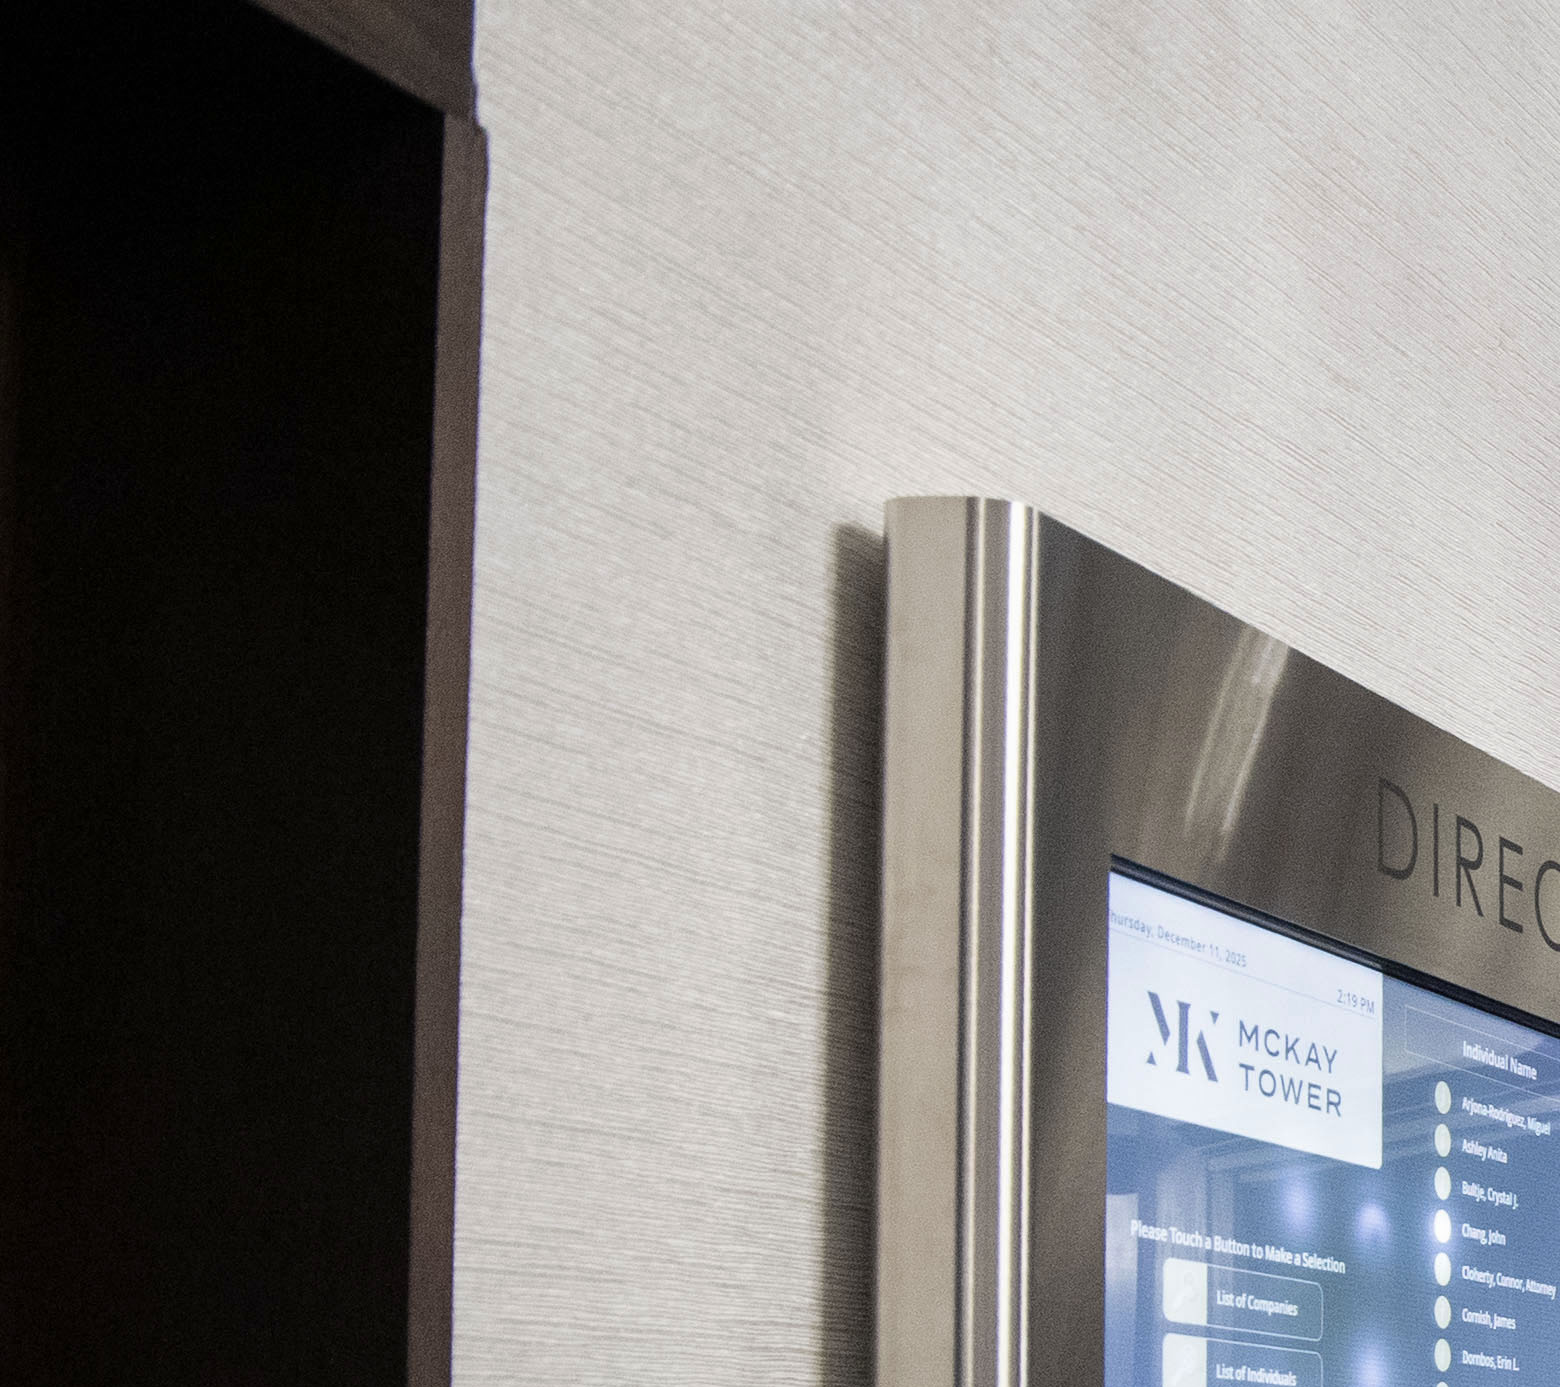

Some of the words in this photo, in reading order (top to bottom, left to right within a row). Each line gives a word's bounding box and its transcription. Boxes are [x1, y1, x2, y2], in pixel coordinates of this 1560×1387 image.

[1157, 925, 1206, 950] December
[1225, 947, 1247, 968] 2025
[1337, 989, 1358, 1008] 2:19
[1360, 997, 1375, 1014] PM
[1239, 1020, 1337, 1074] MCKAY
[1463, 1041, 1508, 1069] Individual
[1510, 1057, 1536, 1080] Name
[1238, 1063, 1341, 1117] TOWER
[1527, 1117, 1550, 1136] Miguel
[1462, 1139, 1486, 1161] Ashley
[1487, 1147, 1507, 1163] Anita
[1487, 1188, 1512, 1206] Crystal
[1131, 1219, 1167, 1242] Please
[1169, 1227, 1202, 1248] Touch
[1205, 1237, 1211, 1249] a
[1214, 1235, 1249, 1256] Button
[1252, 1244, 1262, 1259] to
[1265, 1245, 1292, 1264] Make
[1294, 1254, 1300, 1266] a
[1302, 1252, 1346, 1273] Selection
[1462, 1223, 1487, 1244] Chang,
[1488, 1230, 1506, 1245] John
[1462, 1266, 1495, 1288] Cloherty,
[1496, 1273, 1525, 1292] Connor,
[1526, 1279, 1556, 1299] Attorney
[1216, 1290, 1234, 1306] List
[1236, 1293, 1246, 1308] of
[1247, 1295, 1298, 1316] Companies
[1462, 1308, 1492, 1328] Cornish,
[1493, 1314, 1516, 1329] James
[1216, 1364, 1233, 1379] List
[1235, 1366, 1246, 1380] of
[1247, 1368, 1296, 1386] Individuals
[1497, 1356, 1511, 1370] Erin
